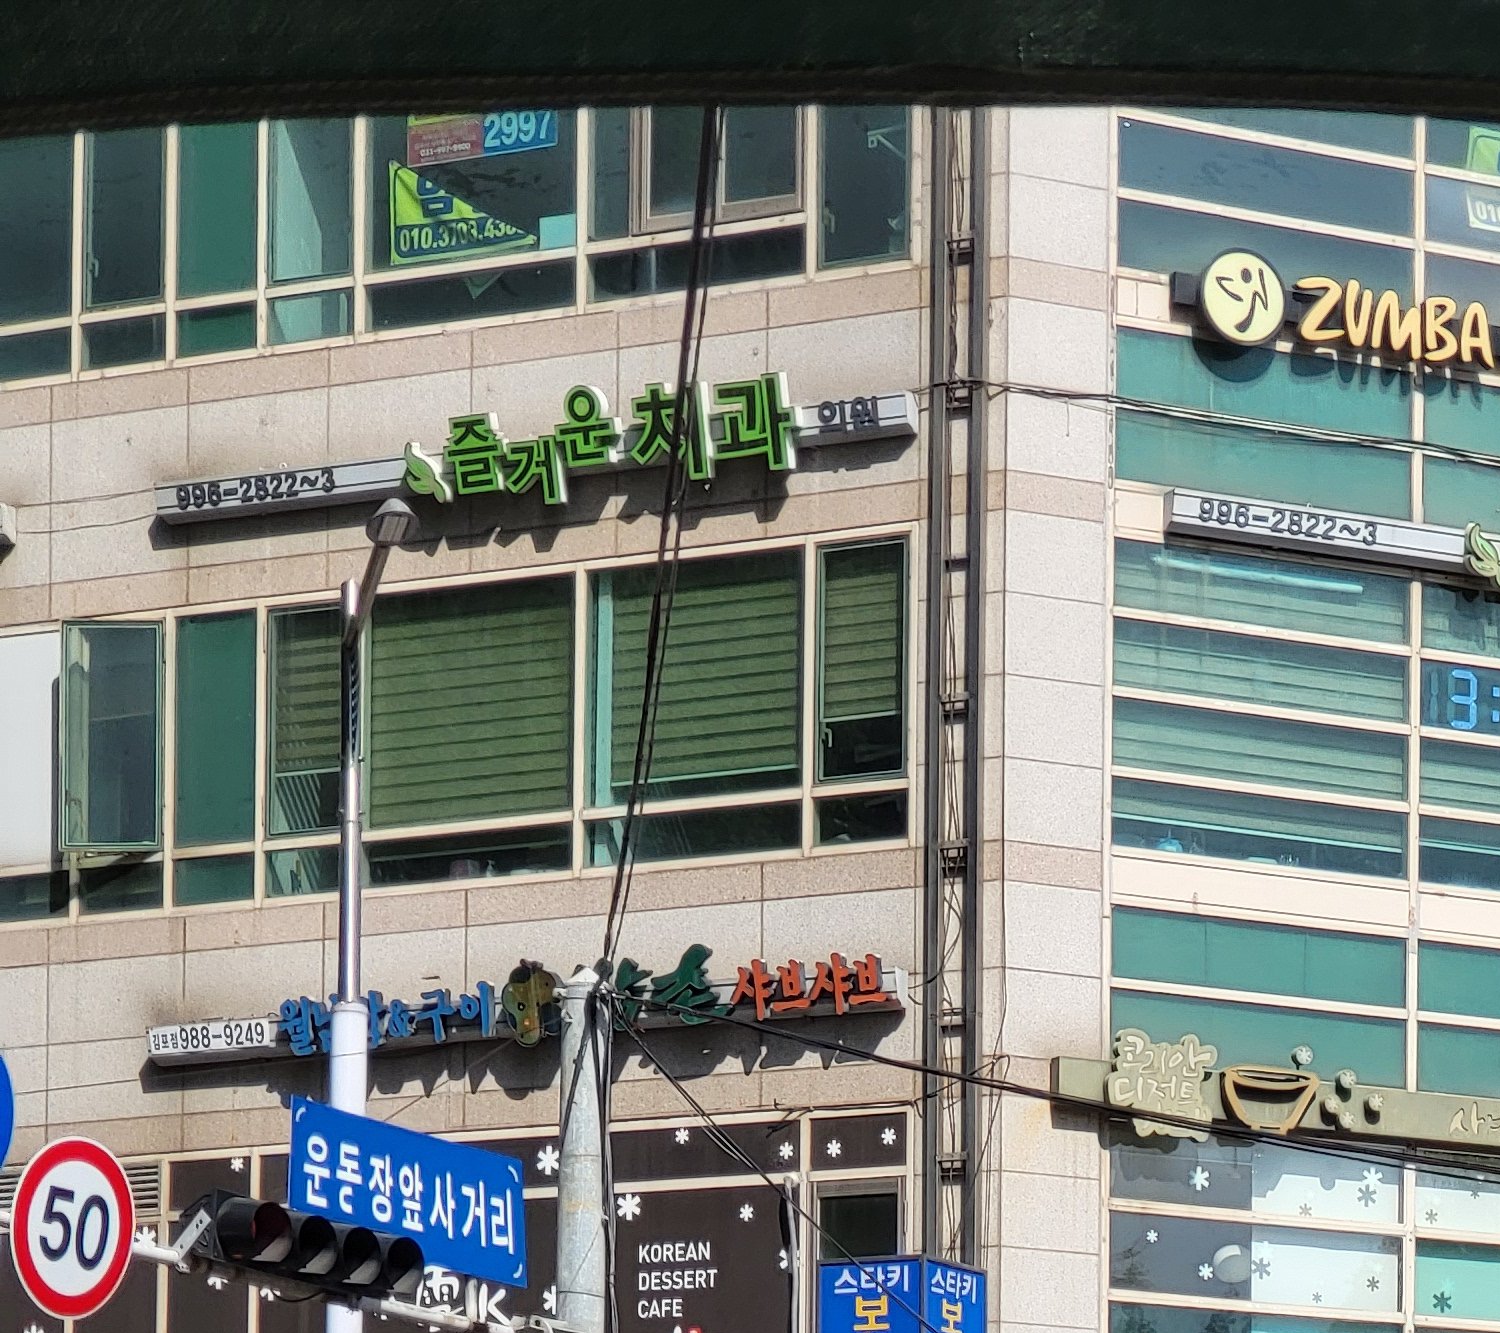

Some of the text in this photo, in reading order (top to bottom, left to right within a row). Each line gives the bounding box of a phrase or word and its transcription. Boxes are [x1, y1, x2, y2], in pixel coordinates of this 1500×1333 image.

[484, 110, 551, 148] 2997
[400, 217, 524, 252] 010.3703.43
[1293, 274, 1494, 368] ZUMBA
[176, 466, 337, 511] 996-2822~3
[816, 396, 881, 435] 의원
[1198, 497, 1379, 547] 996-2822~3
[732, 953, 888, 1021] 샤브샤브
[152, 1022, 266, 1051] 김포점 988-9249
[1114, 1076, 1196, 1105] 디저트
[38, 1186, 111, 1272] 50
[638, 1241, 711, 1264] KOREAN
[638, 1269, 718, 1292] DESSERT
[834, 1264, 910, 1294] 스타키
[931, 1267, 977, 1305] 스타키
[637, 1298, 684, 1319] CAFE
